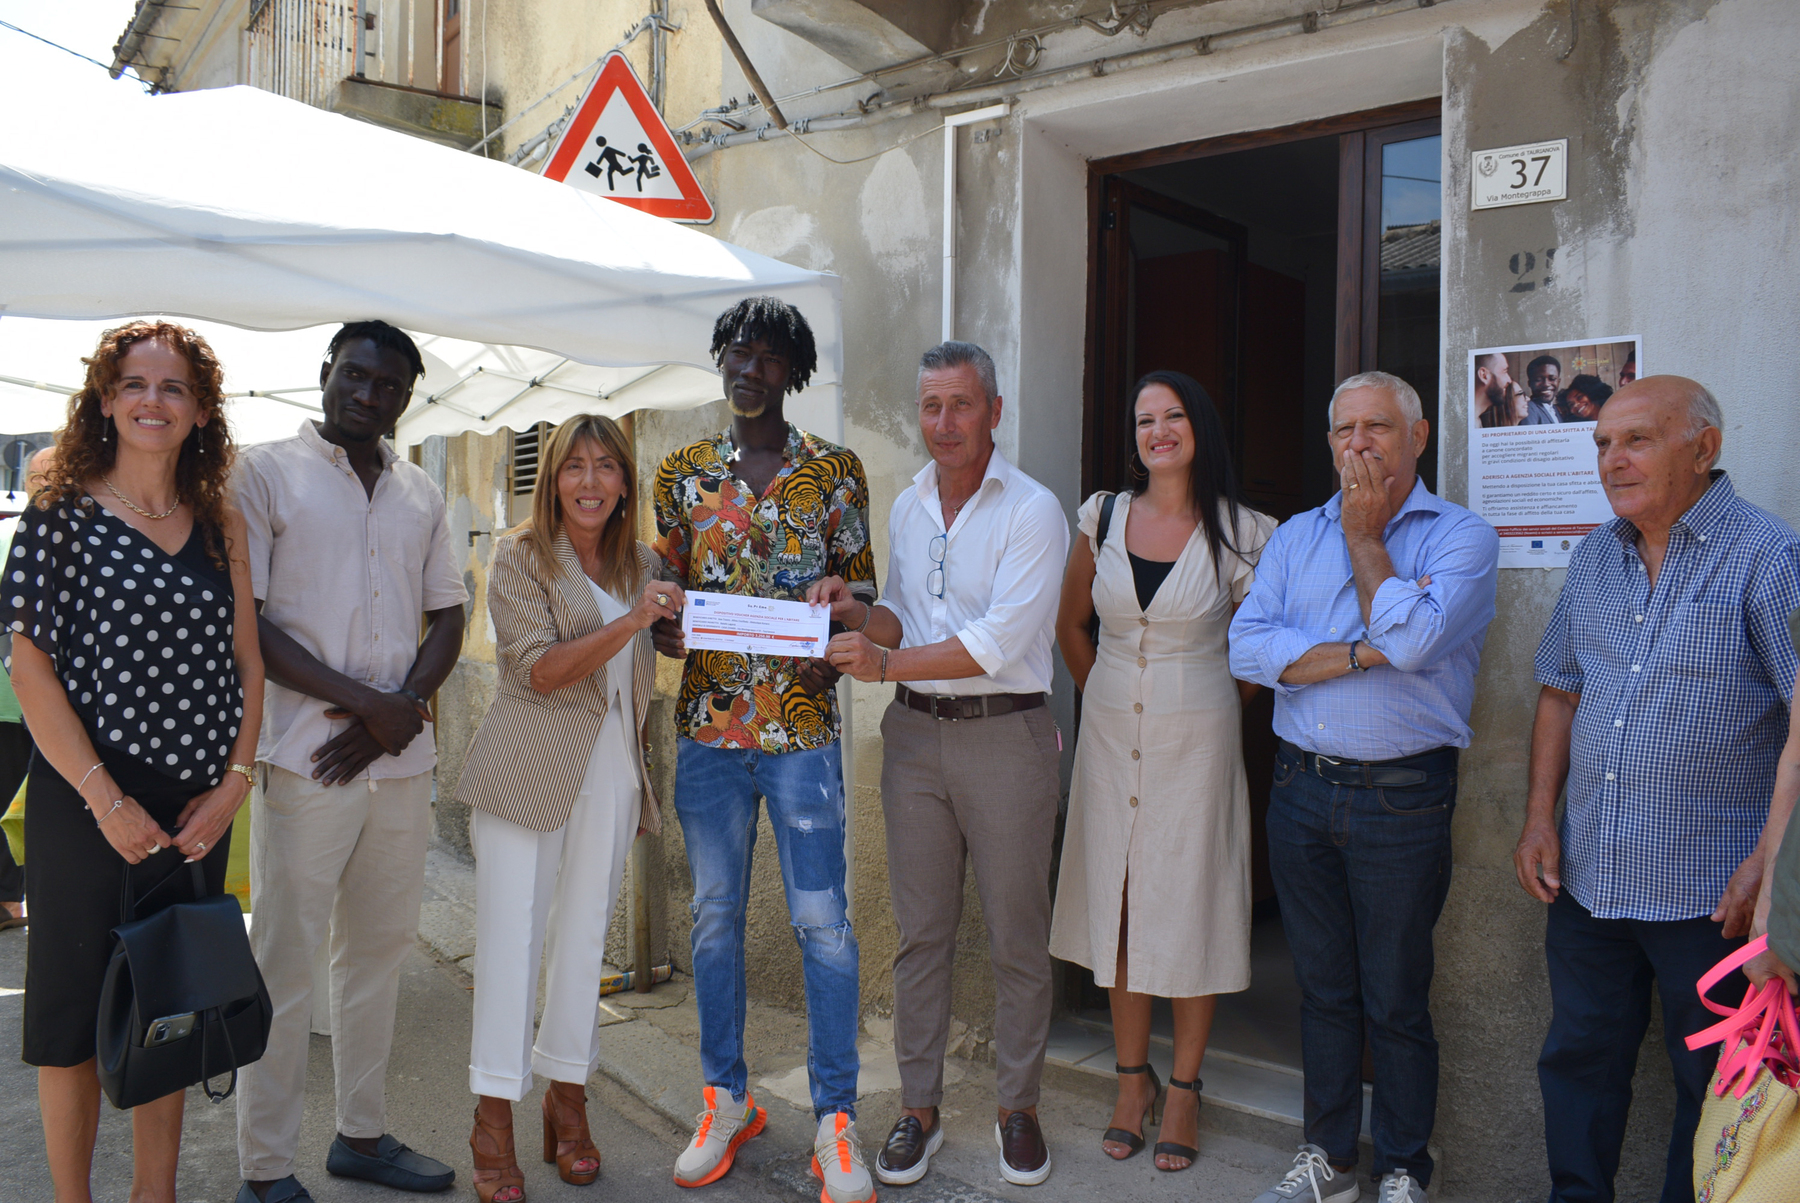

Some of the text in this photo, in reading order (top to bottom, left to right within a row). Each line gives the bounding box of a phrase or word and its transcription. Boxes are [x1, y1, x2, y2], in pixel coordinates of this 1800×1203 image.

[1526, 146, 1560, 156] TAURIANOVA
[1510, 155, 1551, 189] 37
[1501, 189, 1552, 200] Montegrappa
